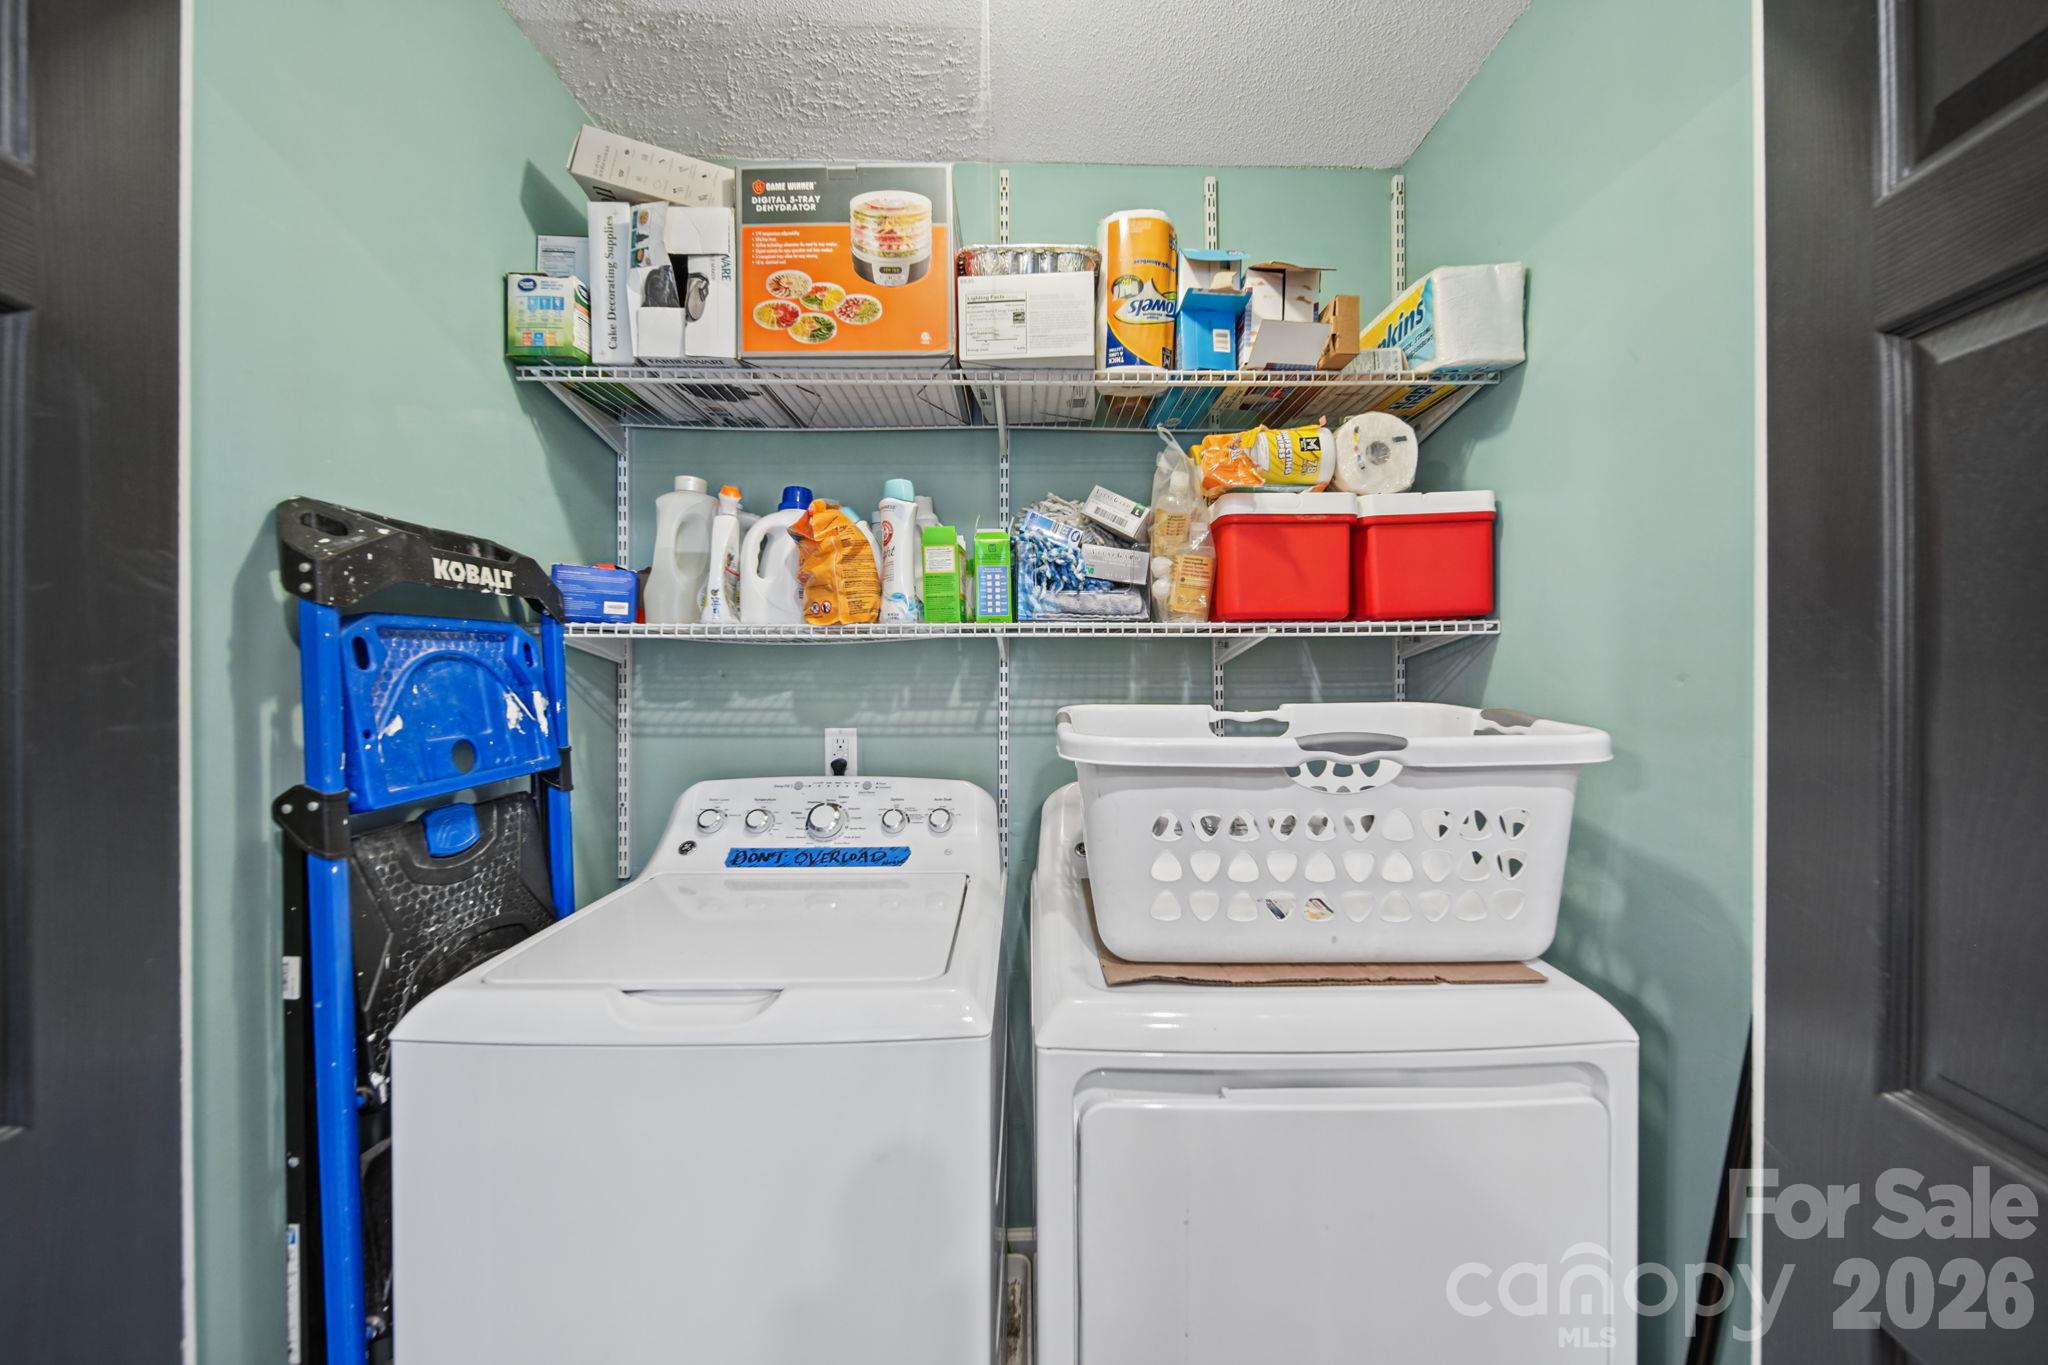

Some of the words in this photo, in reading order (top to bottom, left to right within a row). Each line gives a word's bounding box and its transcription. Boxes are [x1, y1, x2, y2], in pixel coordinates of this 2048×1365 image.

[751, 195, 787, 205] DIGITAL
[755, 203, 817, 212] DEHYDRATOR
[604, 215, 617, 260] Supplies
[605, 261, 618, 321] Decorating
[607, 323, 617, 350] Cake
[1307, 460, 1319, 473] 78
[431, 556, 514, 590] KOBALT
[794, 850, 888, 867] OVERLOAD
